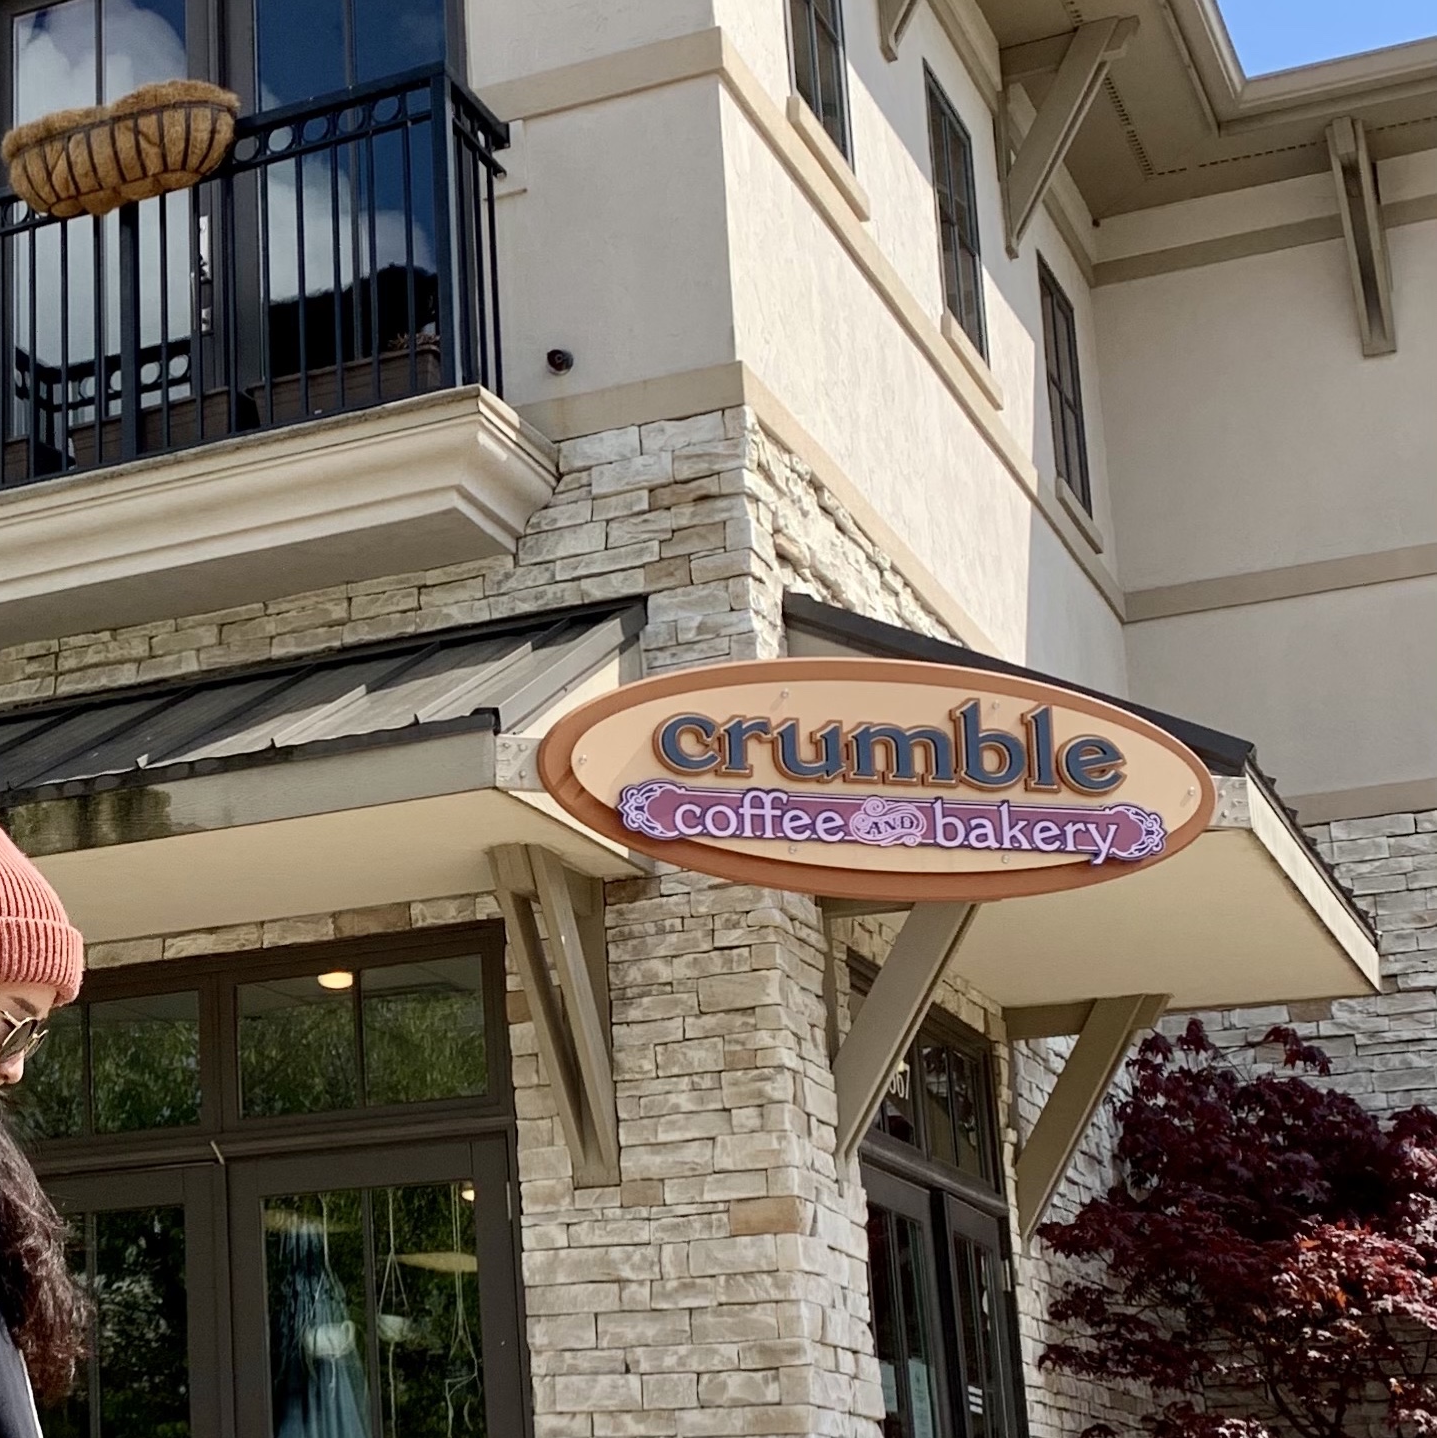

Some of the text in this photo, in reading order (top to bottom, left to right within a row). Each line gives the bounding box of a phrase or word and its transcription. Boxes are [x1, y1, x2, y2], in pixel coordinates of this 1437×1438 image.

[655, 699, 1126, 794] crumble
[674, 790, 1118, 865] coffee AND bakery
